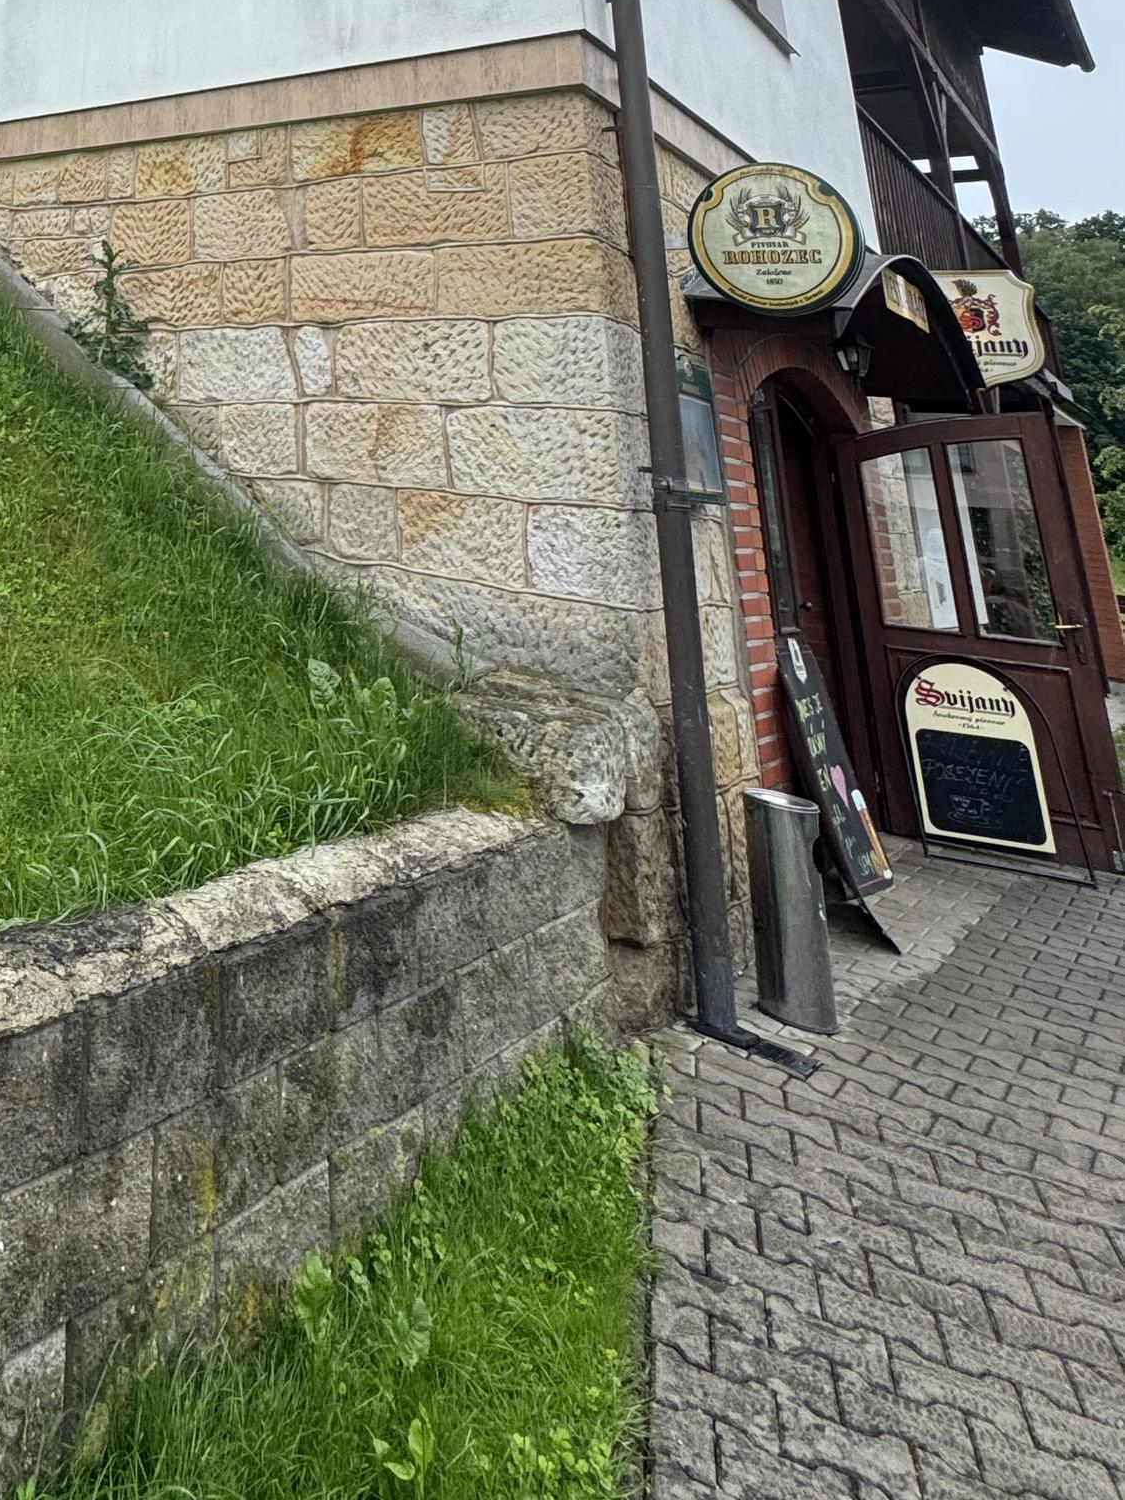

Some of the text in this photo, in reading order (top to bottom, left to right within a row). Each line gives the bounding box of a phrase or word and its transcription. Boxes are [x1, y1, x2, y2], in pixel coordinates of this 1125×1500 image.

[753, 207, 780, 229] R
[751, 241, 789, 249] PIVOVAR
[721, 249, 823, 265] ROHOZEC
[967, 334, 1029, 359] ijany
[913, 678, 1016, 719] Svijany
